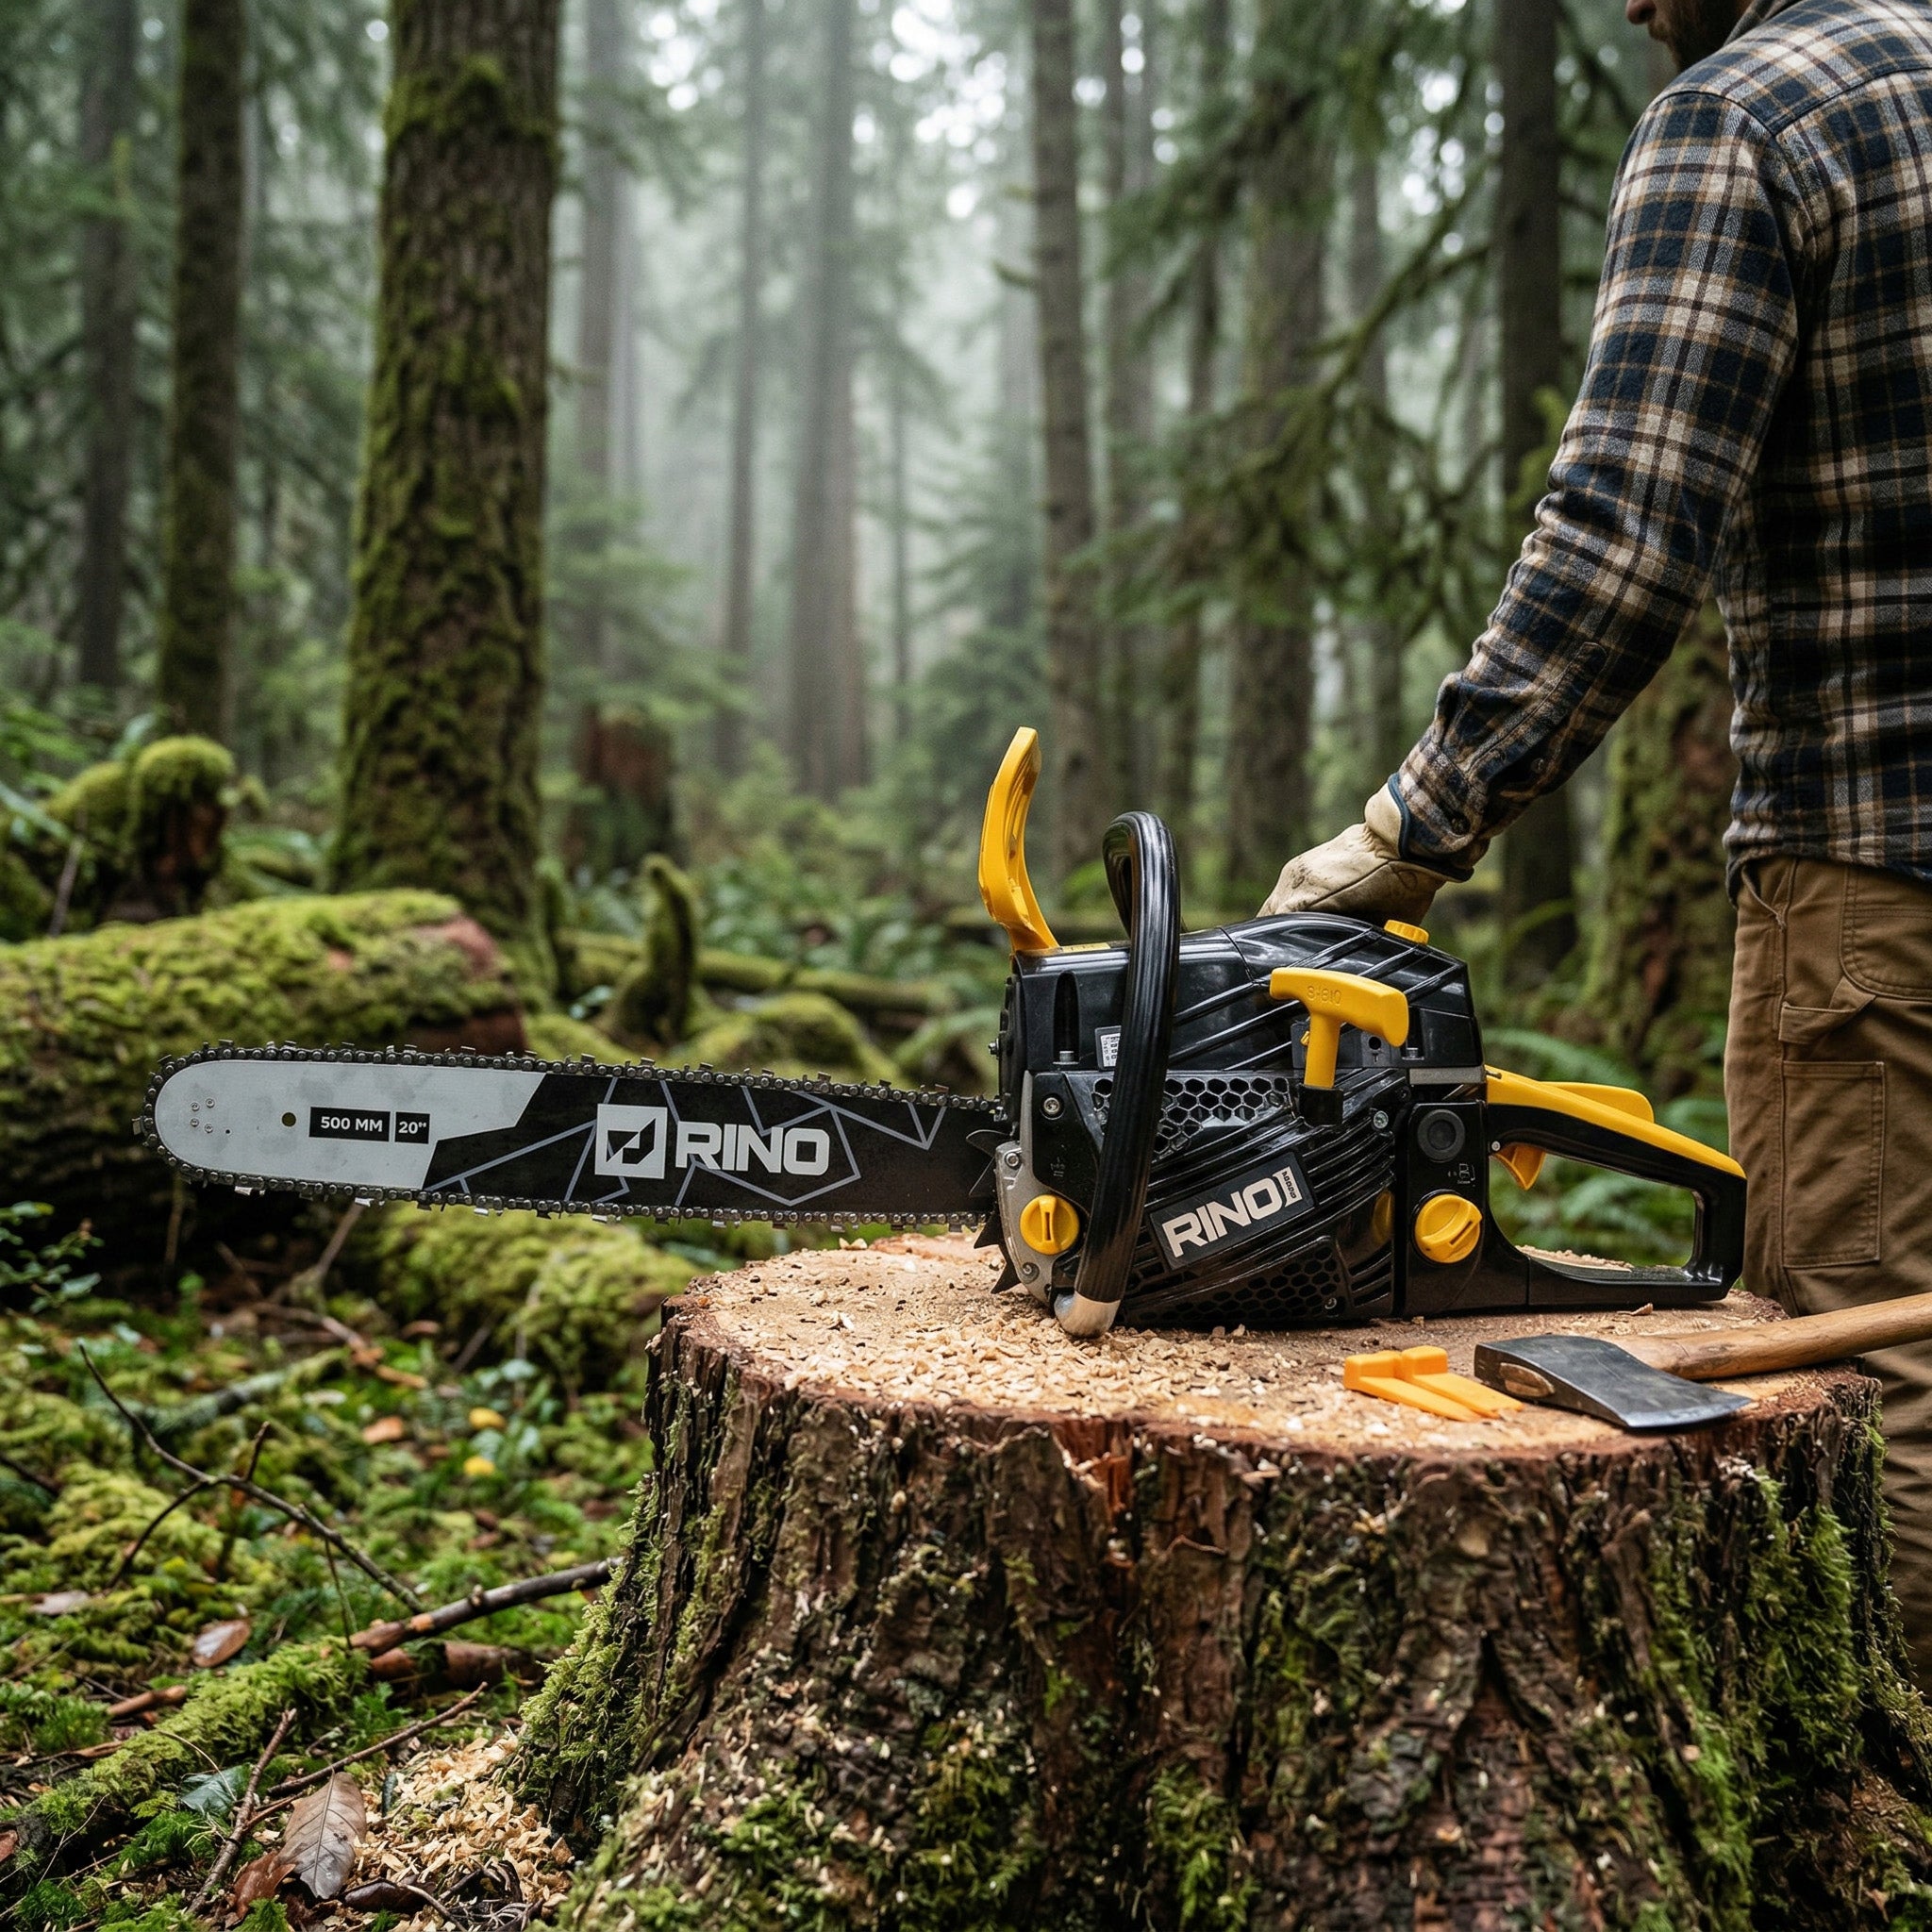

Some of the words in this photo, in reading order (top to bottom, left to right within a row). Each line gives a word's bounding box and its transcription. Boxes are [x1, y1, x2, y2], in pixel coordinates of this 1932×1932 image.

[321, 1116, 351, 1130] 500
[355, 1118, 383, 1133] MM
[398, 1121, 427, 1135] 20"
[675, 1120, 830, 1176] RINO
[1161, 1177, 1283, 1258] RINO
